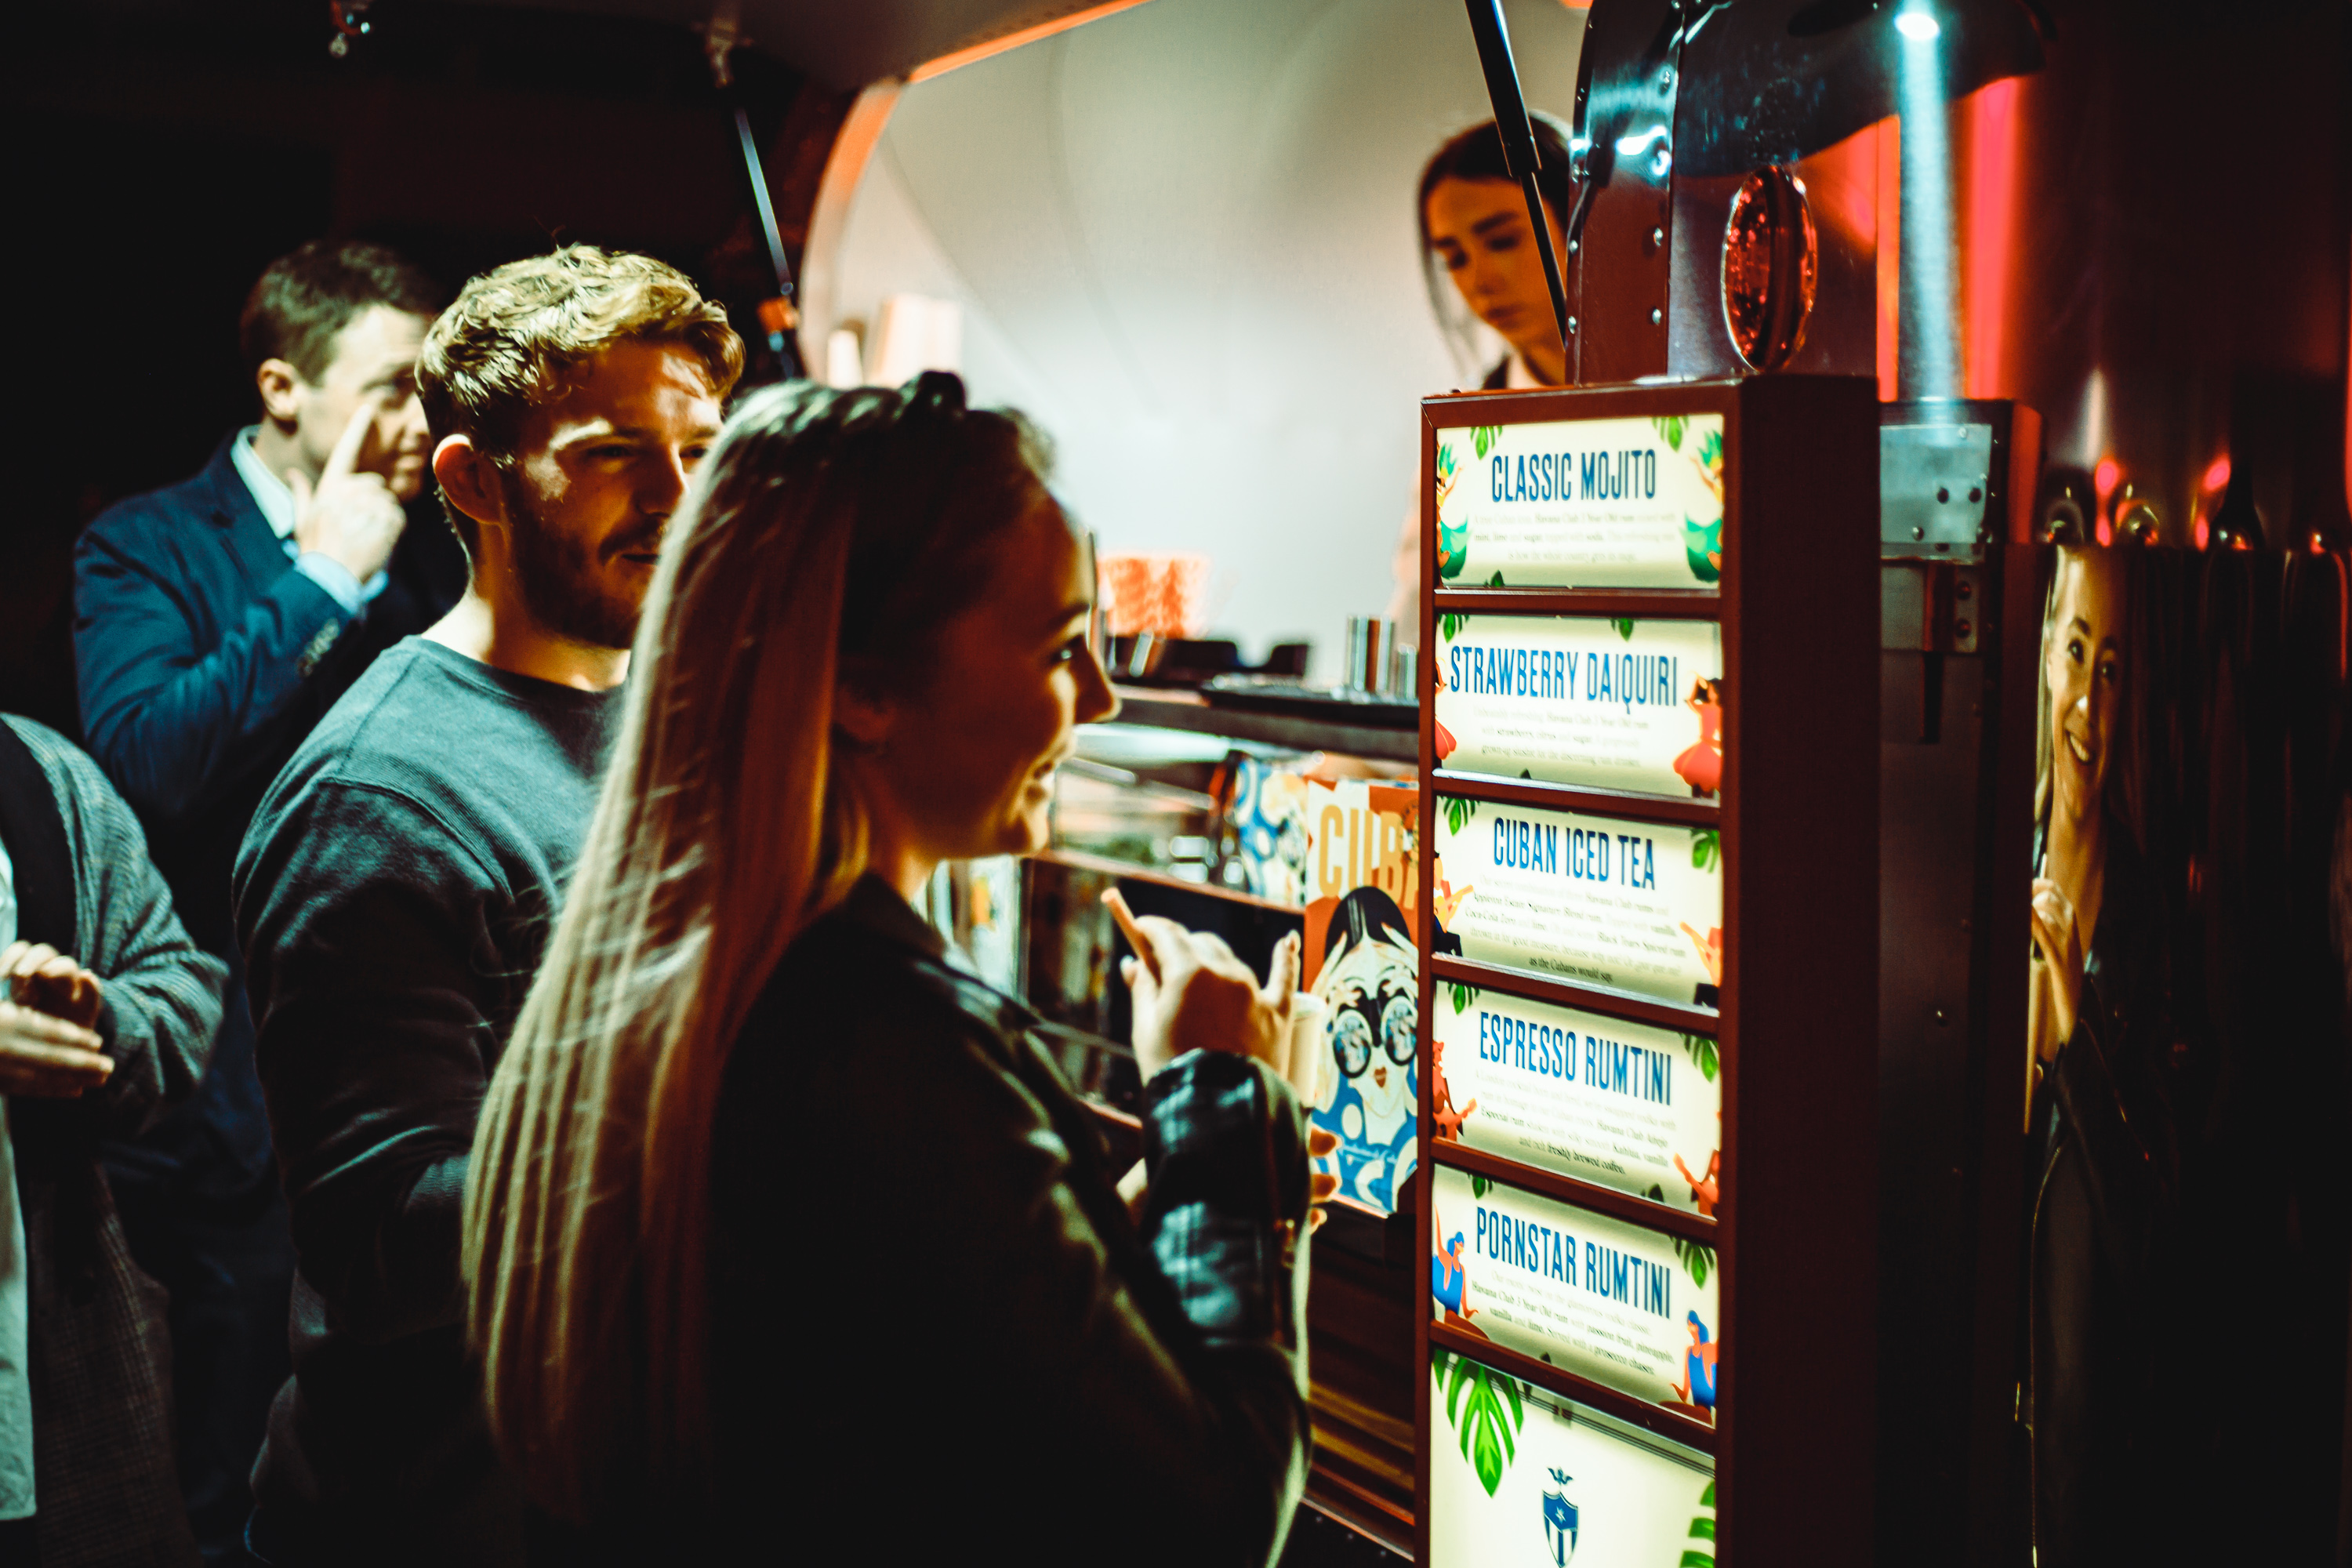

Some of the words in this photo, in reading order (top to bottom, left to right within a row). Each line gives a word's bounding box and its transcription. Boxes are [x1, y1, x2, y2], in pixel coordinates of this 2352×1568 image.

[1491, 452, 1572, 503] CLASSIC
[1581, 448, 1656, 501] MOJITO
[1450, 645, 1578, 699] STRAWBERRY
[1587, 652, 1677, 714] DAIQUIRI
[1494, 817, 1558, 874] CUBAN
[1566, 827, 1610, 882] ICED
[1617, 834, 1655, 890] TEA
[1537, 956, 1549, 970] the
[1577, 967, 1600, 979] would
[1480, 1011, 1576, 1081] ESPRESSO
[1585, 1035, 1671, 1106] RUMTINI
[1547, 1141, 1571, 1161] freshly
[1573, 1149, 1600, 1168] brewed
[1476, 1206, 1577, 1287] PORNSTAR
[1586, 1241, 1671, 1319] RUMTINI
[1472, 1279, 1497, 1298] Havana
[1498, 1290, 1515, 1305] Club
[1554, 1312, 1568, 1324] rum
[1586, 1324, 1615, 1342] passion
[1490, 1307, 1512, 1323] vanilla
[1594, 1345, 1628, 1365] prosecco
